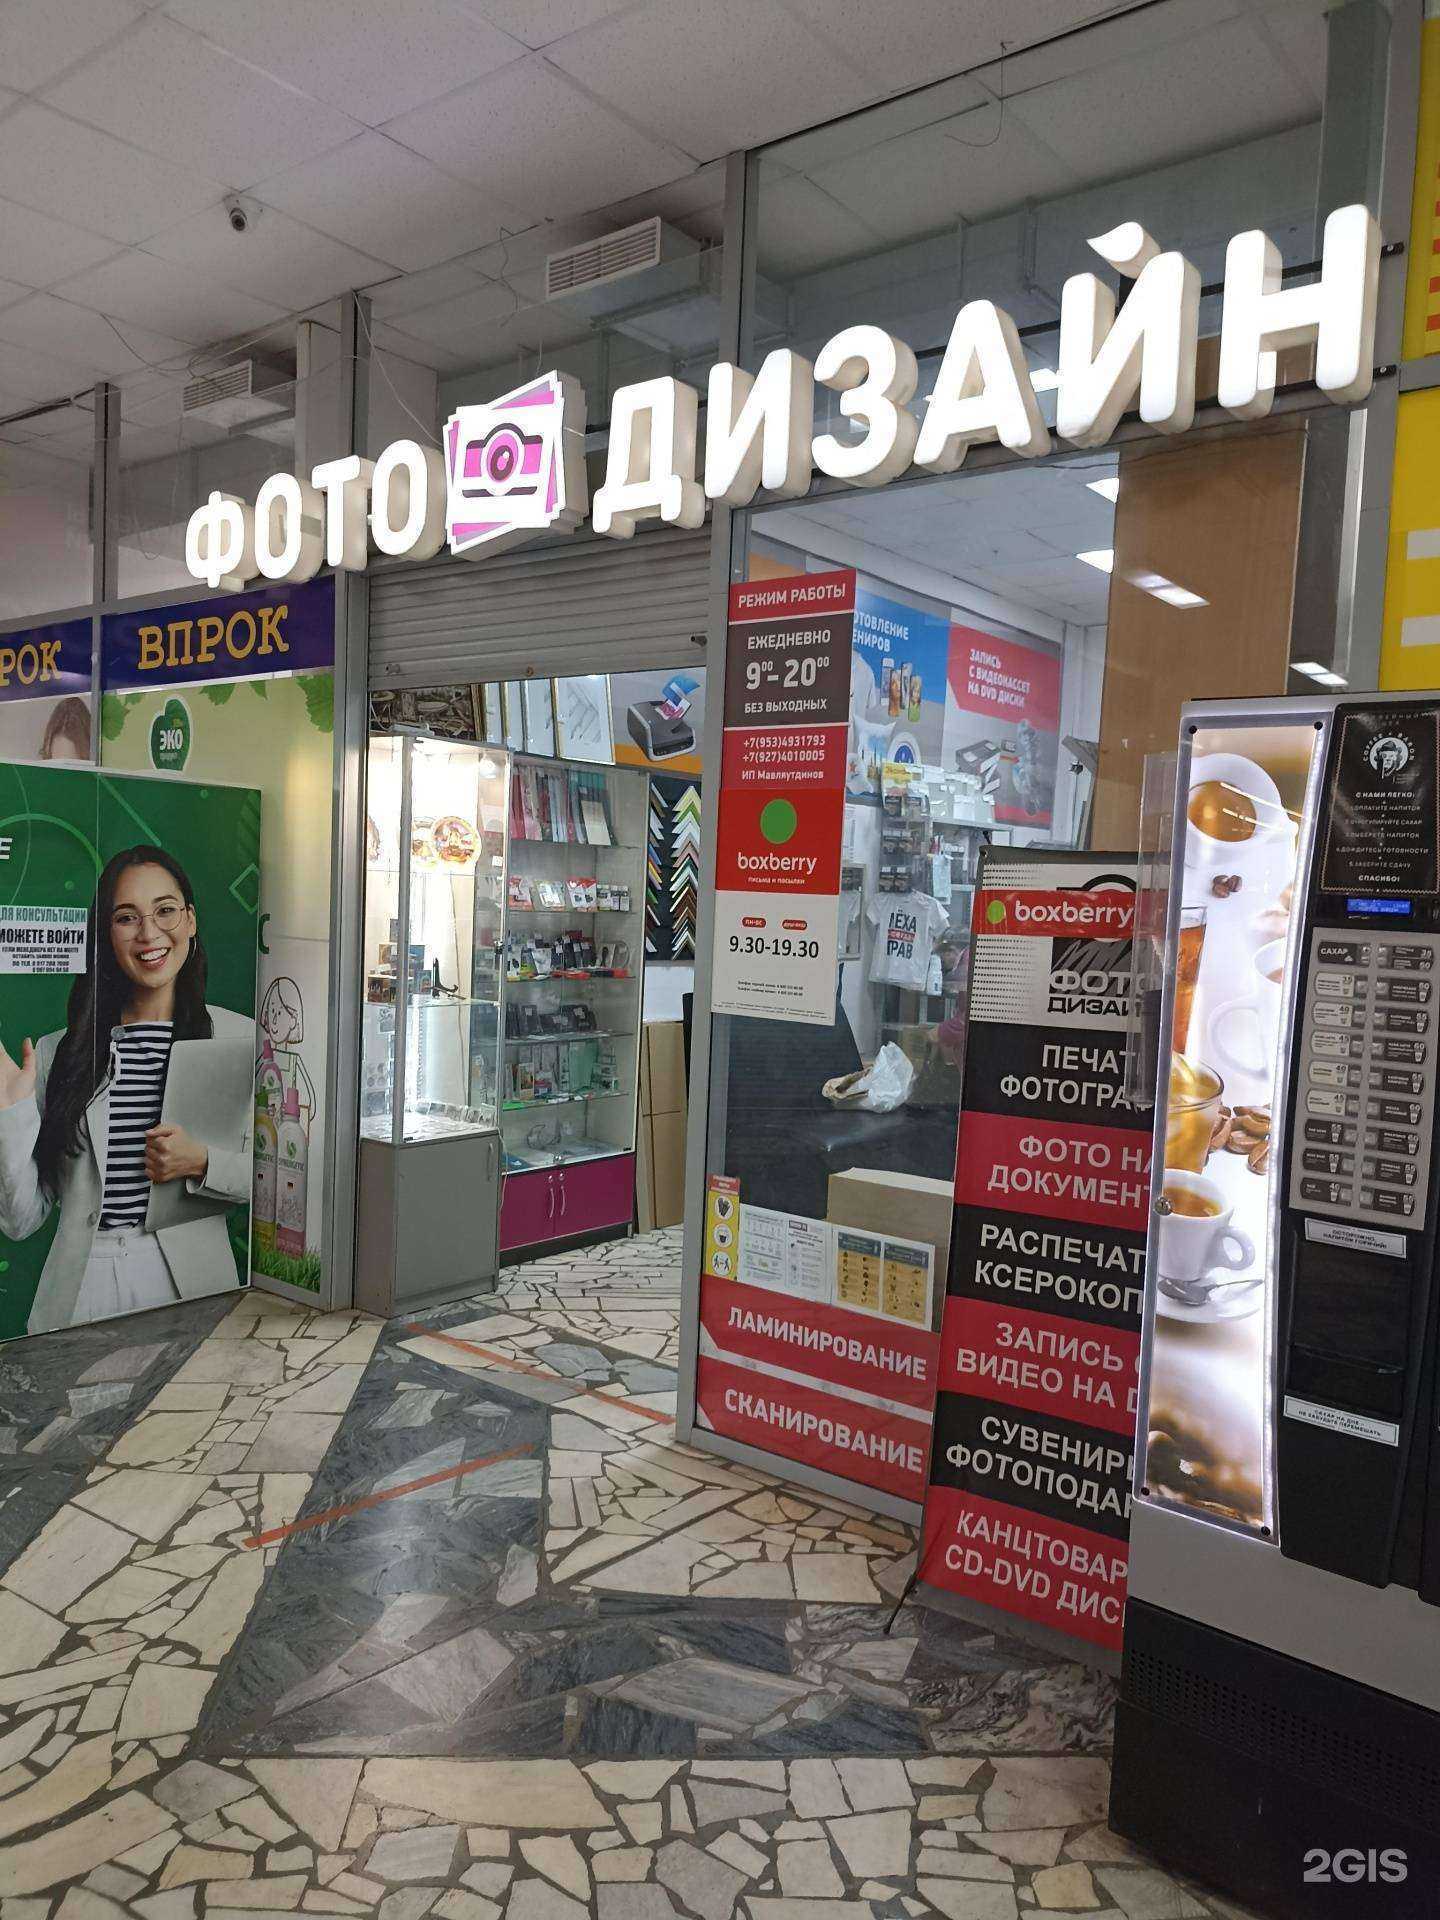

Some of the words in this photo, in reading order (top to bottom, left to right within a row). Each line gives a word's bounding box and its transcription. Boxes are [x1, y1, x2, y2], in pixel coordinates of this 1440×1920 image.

[185, 438, 430, 588] ФОТО
[592, 203, 1374, 537] ДИЗАЙН
[738, 592, 787, 608] РЕЖИМ
[790, 583, 846, 601] РАБОТЫ
[137, 604, 289, 670] ВПРОК
[747, 629, 831, 650] ЕЖЕДНЕВНО
[969, 648, 1002, 668] ЗАПИСЬ
[976, 667, 1031, 692] ВИДЕОКАССЕТ
[744, 701, 763, 714] БЕЗ
[766, 698, 827, 713] ВЫХОДНЫХ
[967, 682, 980, 696] НА
[981, 684, 997, 700] DVD
[997, 689, 1025, 708] ДИСКИ
[159, 728, 184, 750] ЭКО
[742, 770, 755, 780] ИП
[737, 851, 818, 875] boxberry
[0, 907, 14, 921] ЛЯ
[16, 907, 86, 924] КОНСУЛЬТАЦИИ
[1014, 900, 1136, 929] boxberry
[46, 926, 84, 945] ВОЙТИ
[729, 935, 820, 959] 9.30-19.30
[1320, 947, 1348, 956] САХАР
[1018, 1135, 1111, 1168] ФОТО
[987, 1164, 1150, 1209] ДОКУМЕН
[979, 1223, 1147, 1275] РАСПЕЧАТ
[974, 1259, 1143, 1315] КСЕРОКОП
[727, 1306, 928, 1381] ЛАМИНИРОВАНИЕ
[996, 1322, 1124, 1372] ЗАПИСЬ
[956, 1348, 1063, 1394] ВИДЕО
[1072, 1374, 1116, 1409] НА
[724, 1388, 924, 1473] СКАНИРОВАНИЕ
[957, 1509, 1128, 1585] КАНЦТОВАР
[945, 1543, 1051, 1600] CD-DVD
[1056, 1581, 1126, 1628] ДИС
